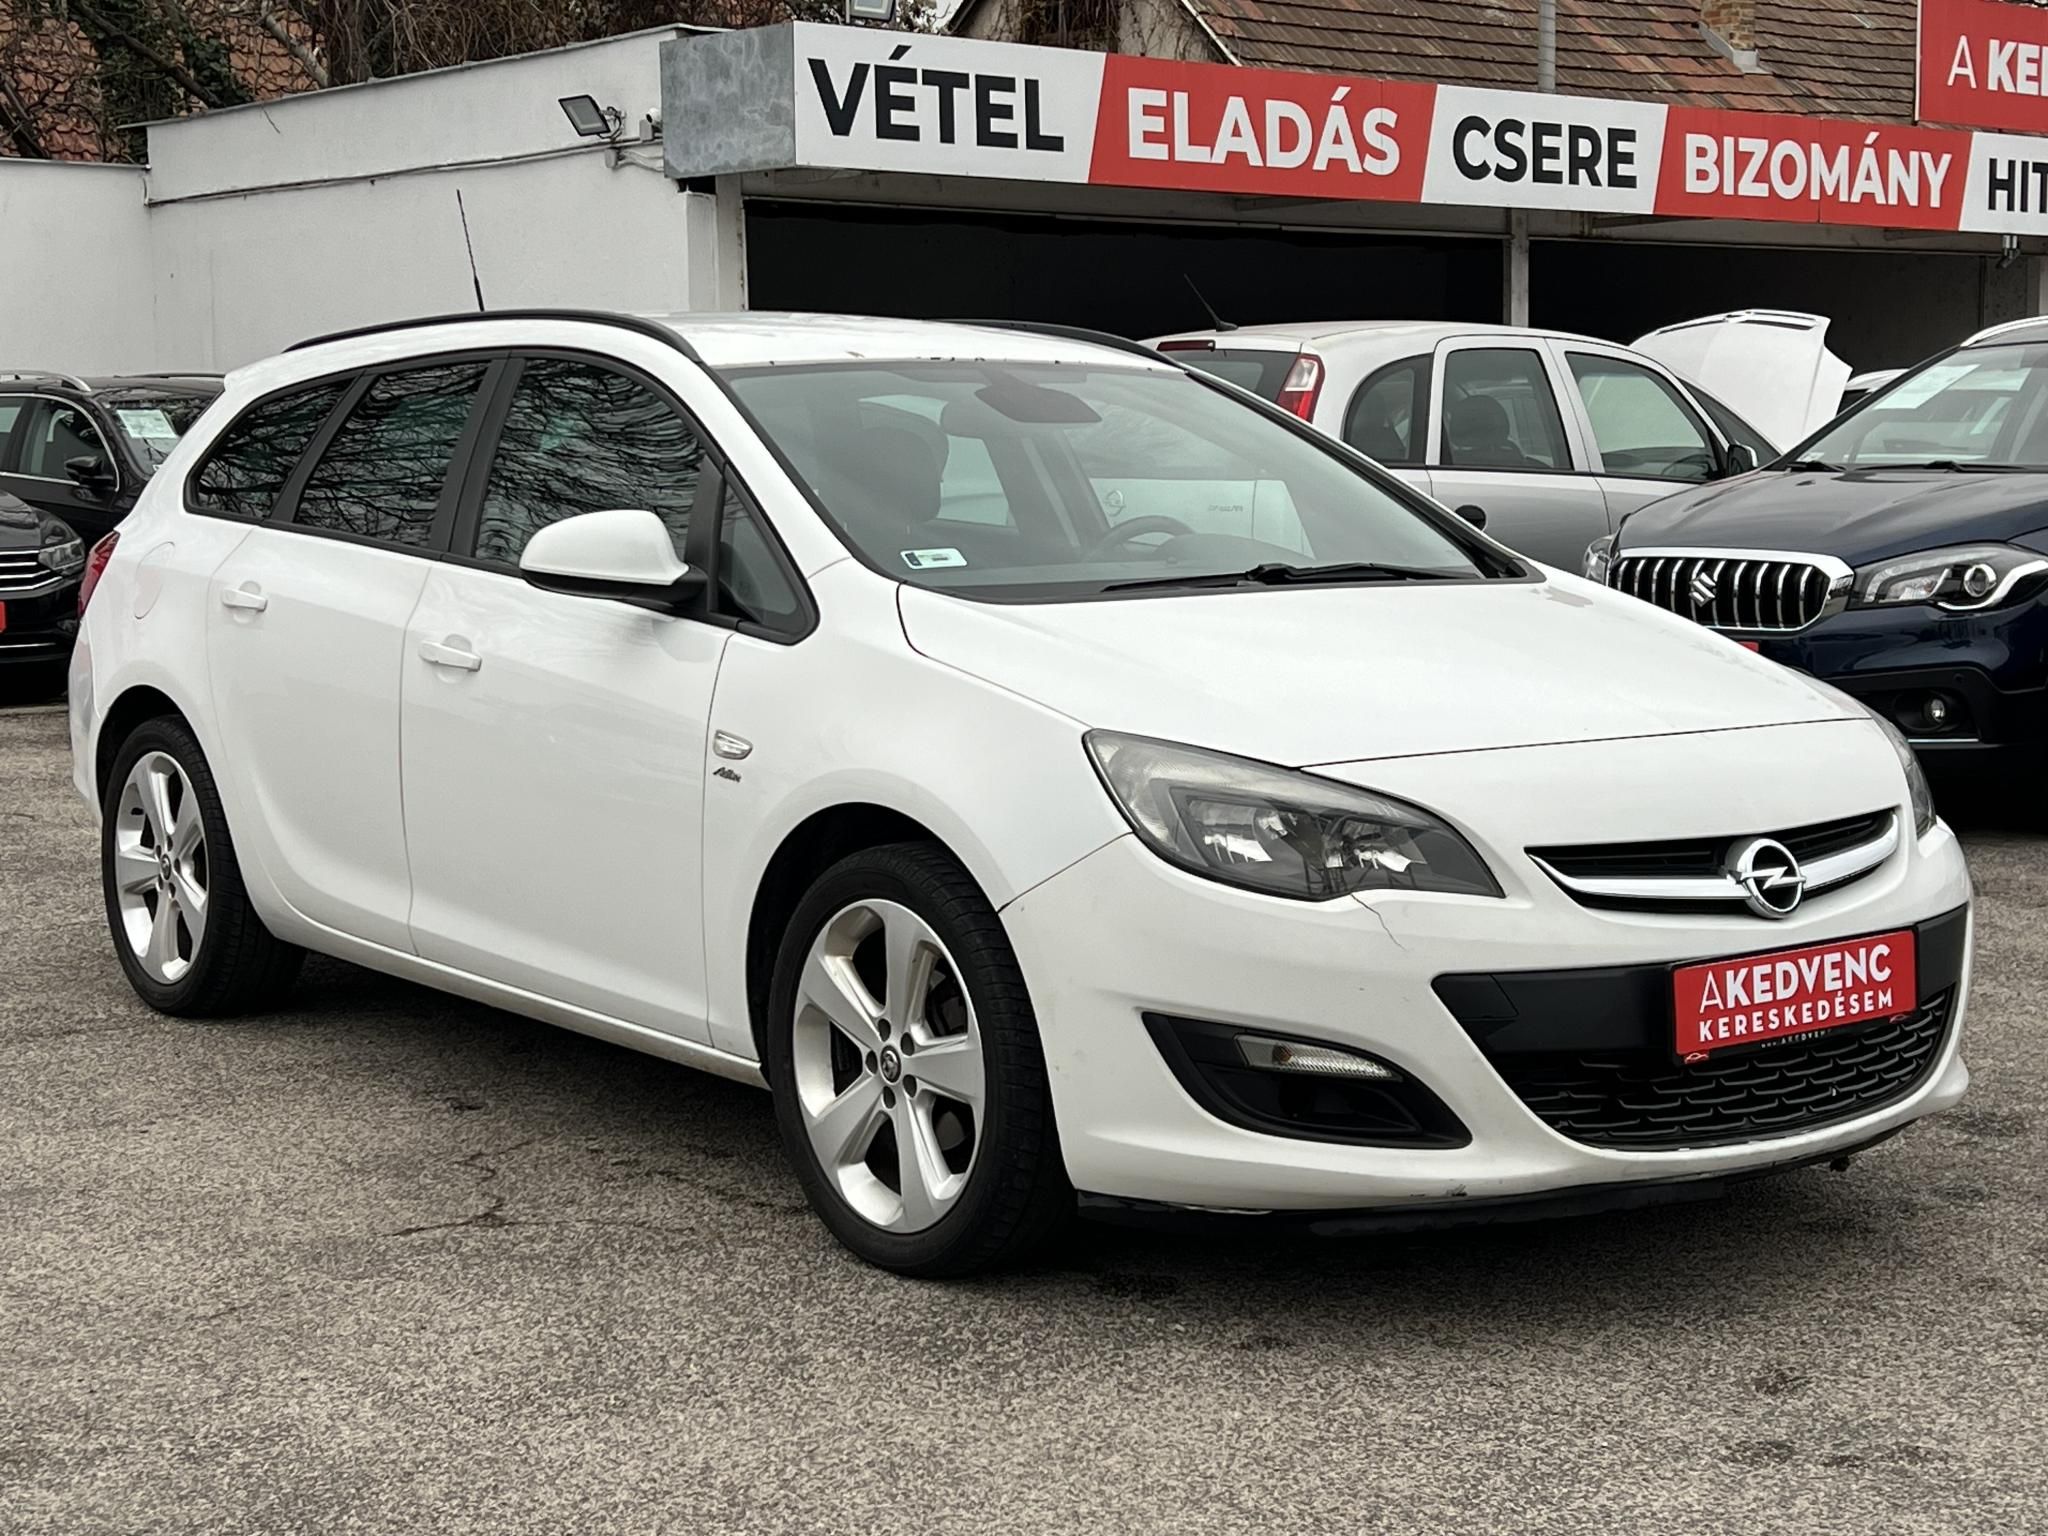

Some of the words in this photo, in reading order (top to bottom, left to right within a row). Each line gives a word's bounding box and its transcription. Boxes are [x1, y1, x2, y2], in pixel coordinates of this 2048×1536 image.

[1947, 35, 1977, 89] A
[1987, 39, 2048, 97] KE
[807, 45, 1065, 153] VÉTEL
[1127, 87, 1400, 176] ELADÁS
[1452, 115, 1637, 189] CSERE
[1685, 131, 1952, 208] BIZOMÁNY
[1987, 157, 2048, 214] HIT
[1699, 987, 1892, 1042] KERESKEDÉSEM
